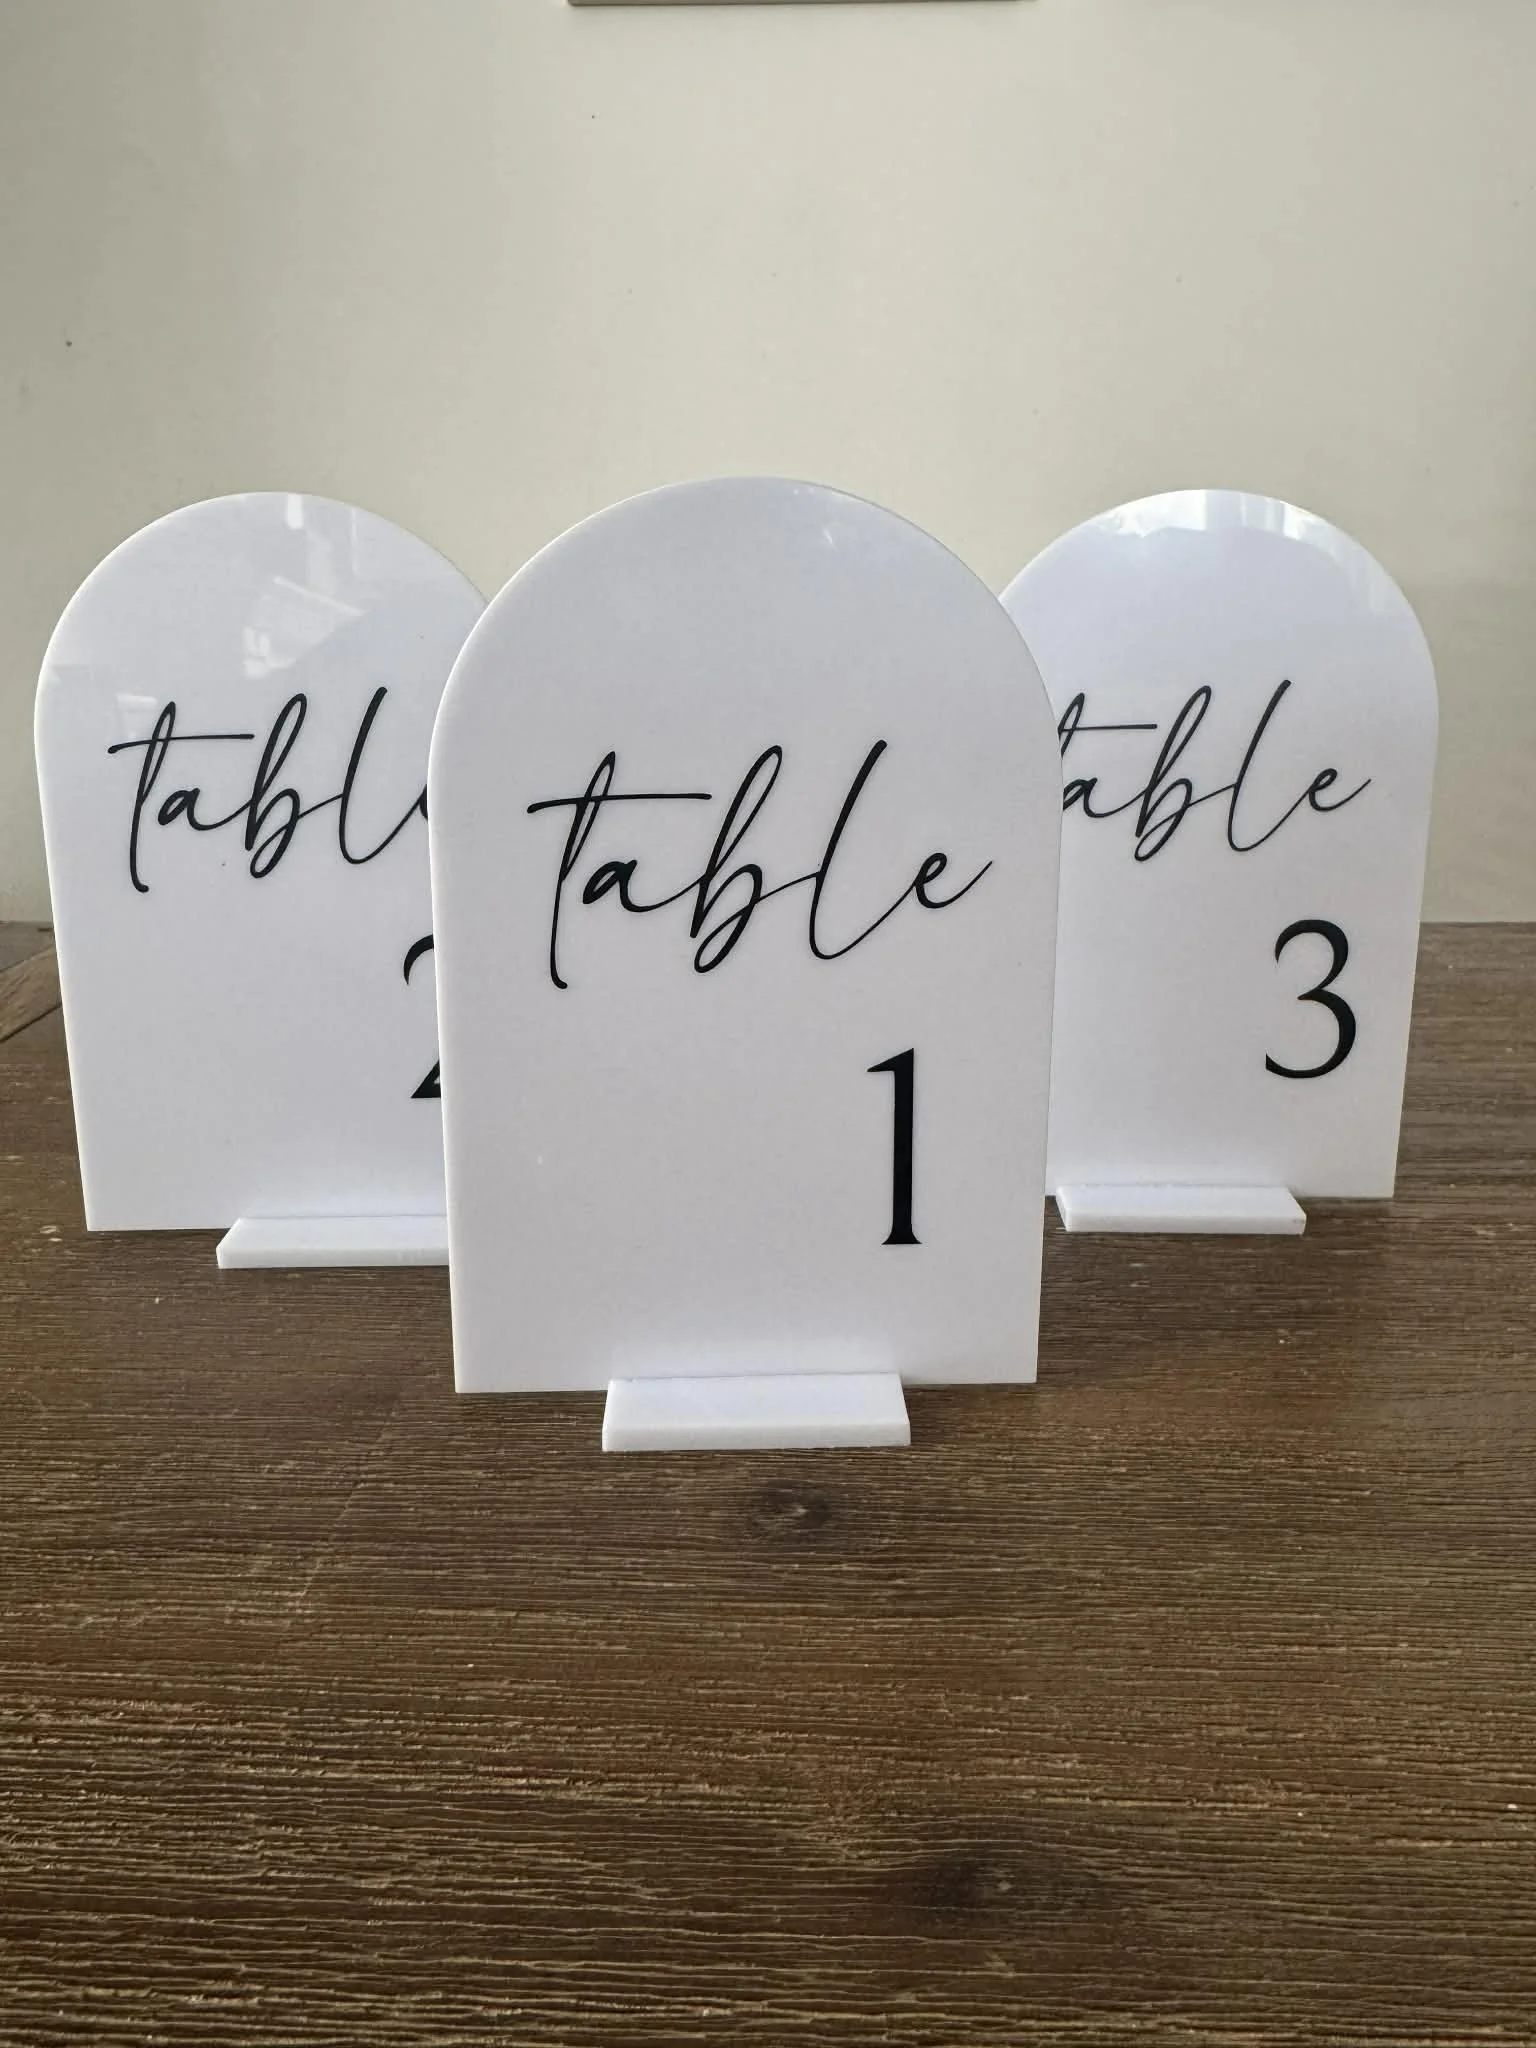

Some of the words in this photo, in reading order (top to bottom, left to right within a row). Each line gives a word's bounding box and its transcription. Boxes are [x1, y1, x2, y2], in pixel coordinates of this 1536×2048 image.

[107, 686, 429, 894] tabl
[526, 739, 993, 990] table
[1265, 919, 1357, 1080] 3
[866, 1047, 923, 1246] 1
